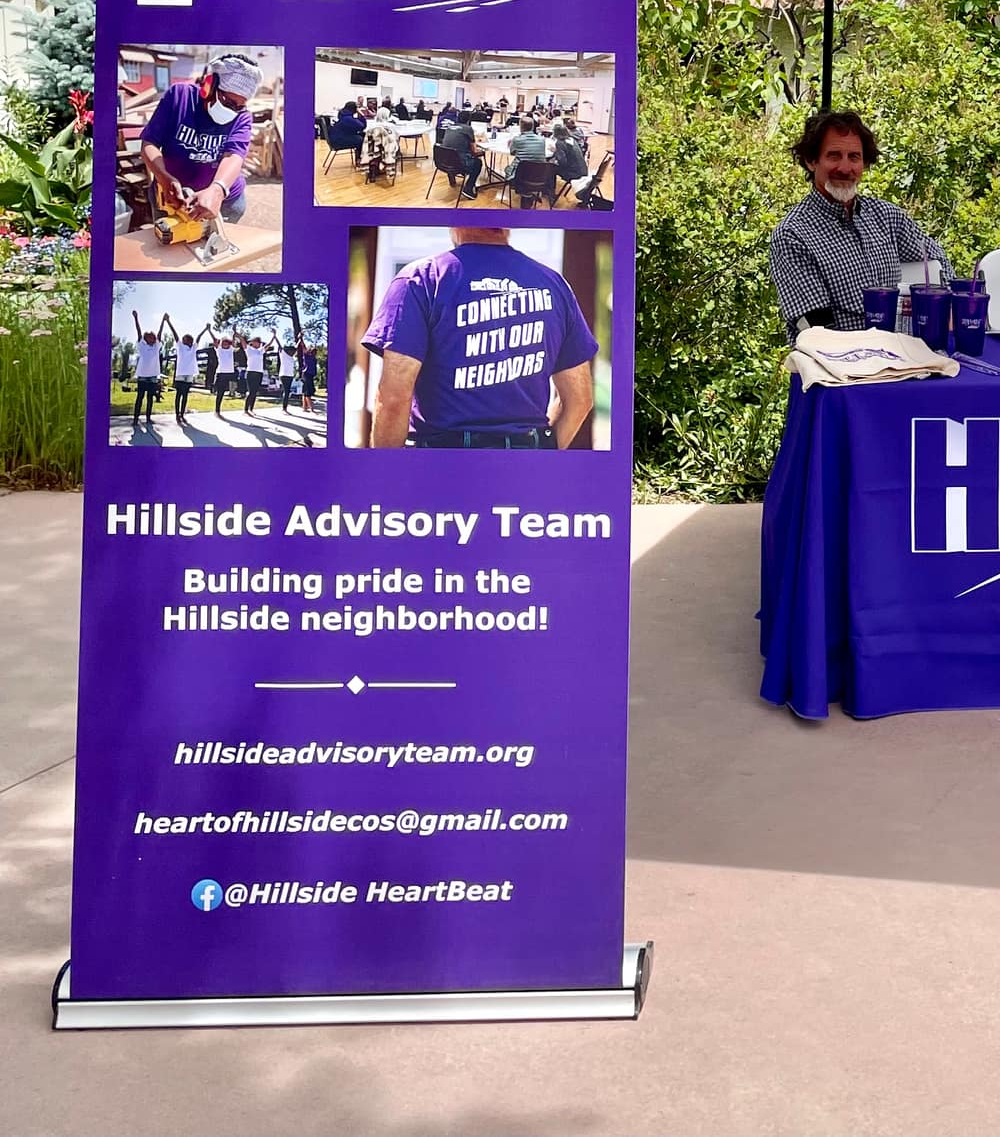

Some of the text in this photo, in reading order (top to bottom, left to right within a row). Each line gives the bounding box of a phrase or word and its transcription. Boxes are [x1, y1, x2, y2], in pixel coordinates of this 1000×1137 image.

[456, 289, 553, 328] CONNECTING
[508, 320, 545, 348] OUR
[107, 503, 611, 545] Hillside Advisory Team
[184, 567, 531, 600] Building pride in the
[163, 604, 548, 636] Hillside neighborhood!
[174, 741, 535, 768] hillsideadvisoryteam.org
[134, 808, 568, 836] heartofhillsidecos@gmail.com
[225, 881, 358, 907] @Hillside
[365, 879, 514, 903] HeartBeat
